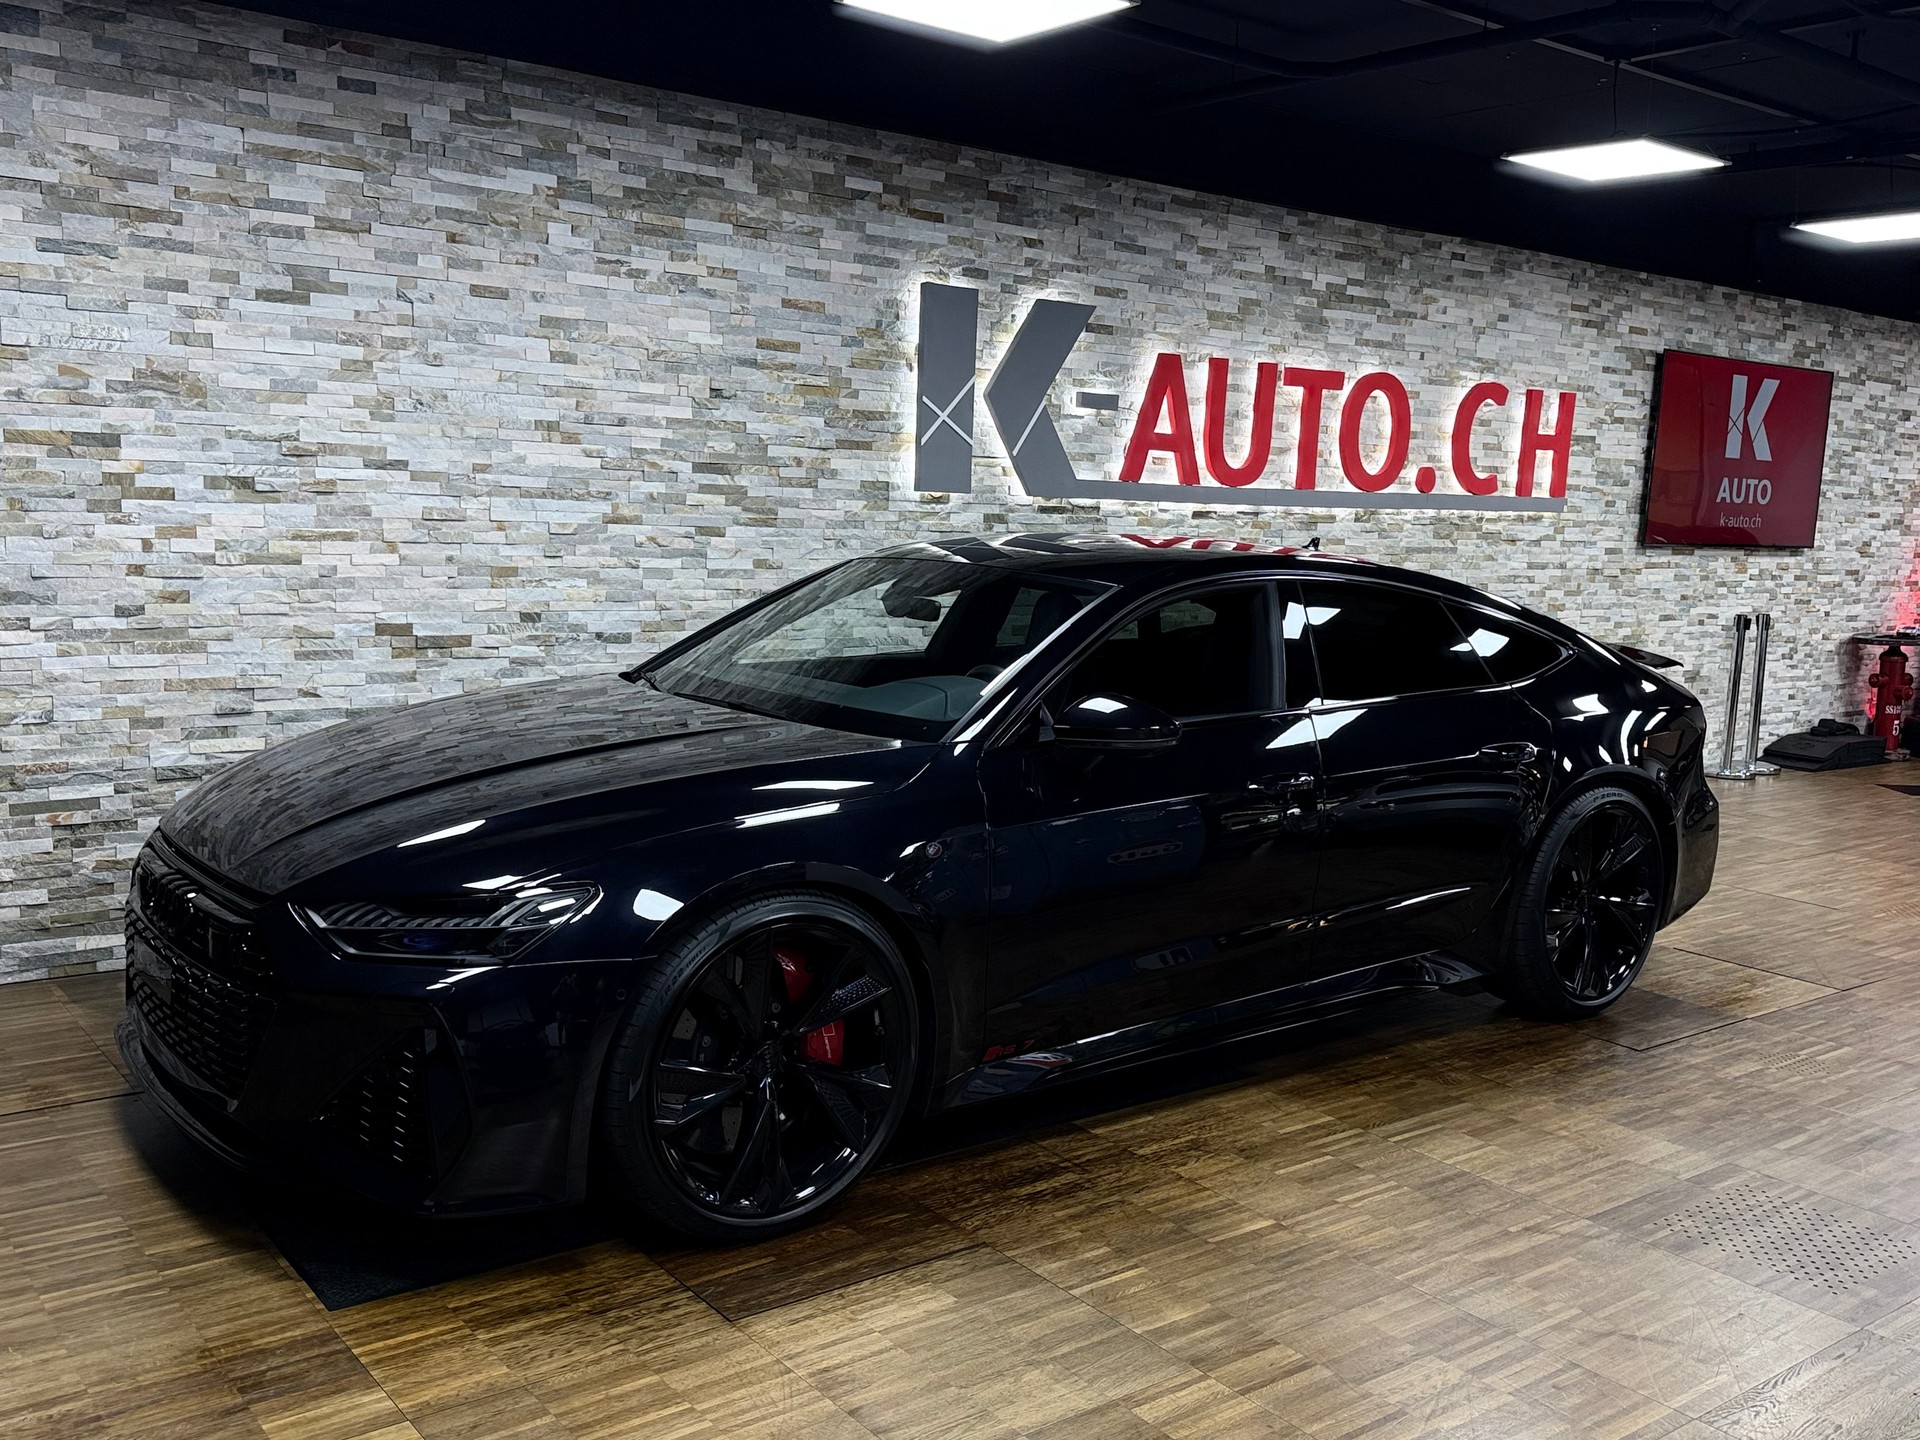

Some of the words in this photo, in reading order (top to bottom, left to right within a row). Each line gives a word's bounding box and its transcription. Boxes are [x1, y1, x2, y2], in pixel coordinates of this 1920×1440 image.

[914, 281, 1576, 501] K-AUTO.CH
[1725, 374, 1781, 462] K
[1716, 477, 1772, 505] AUTO
[1719, 512, 1762, 529] k-auto.ch
[1892, 719, 1900, 737] 5
